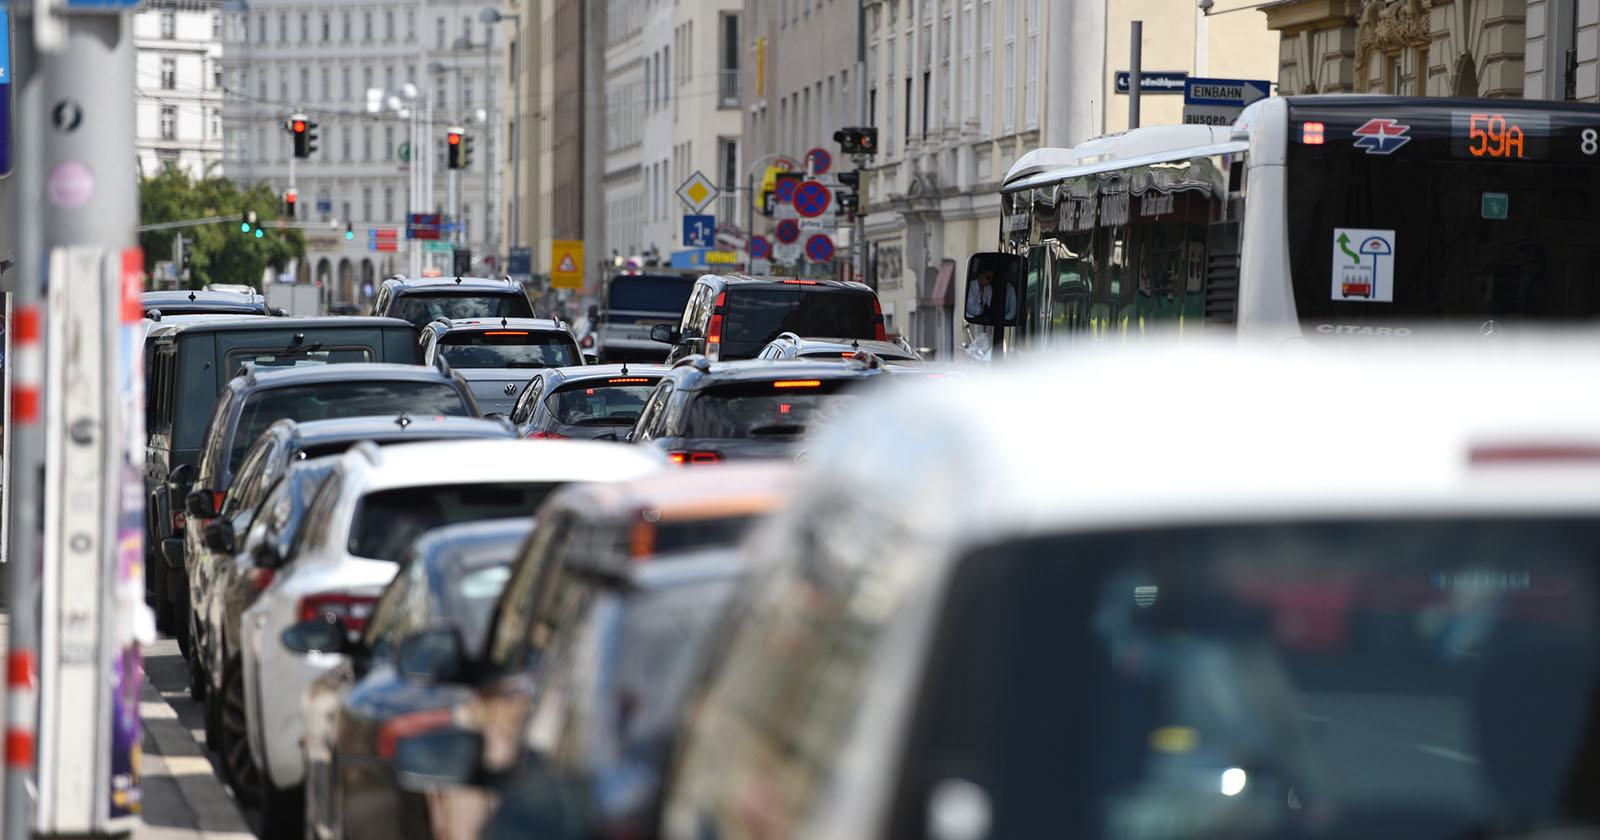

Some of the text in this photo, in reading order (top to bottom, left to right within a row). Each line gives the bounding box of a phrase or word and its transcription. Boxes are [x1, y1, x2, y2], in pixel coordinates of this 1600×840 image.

[1193, 86, 1242, 98] EINBAHN
[1186, 114, 1228, 125] ausgen.
[1469, 114, 1524, 158] 59A
[1581, 128, 1598, 155] 8
[1316, 324, 1412, 337] CITARO
